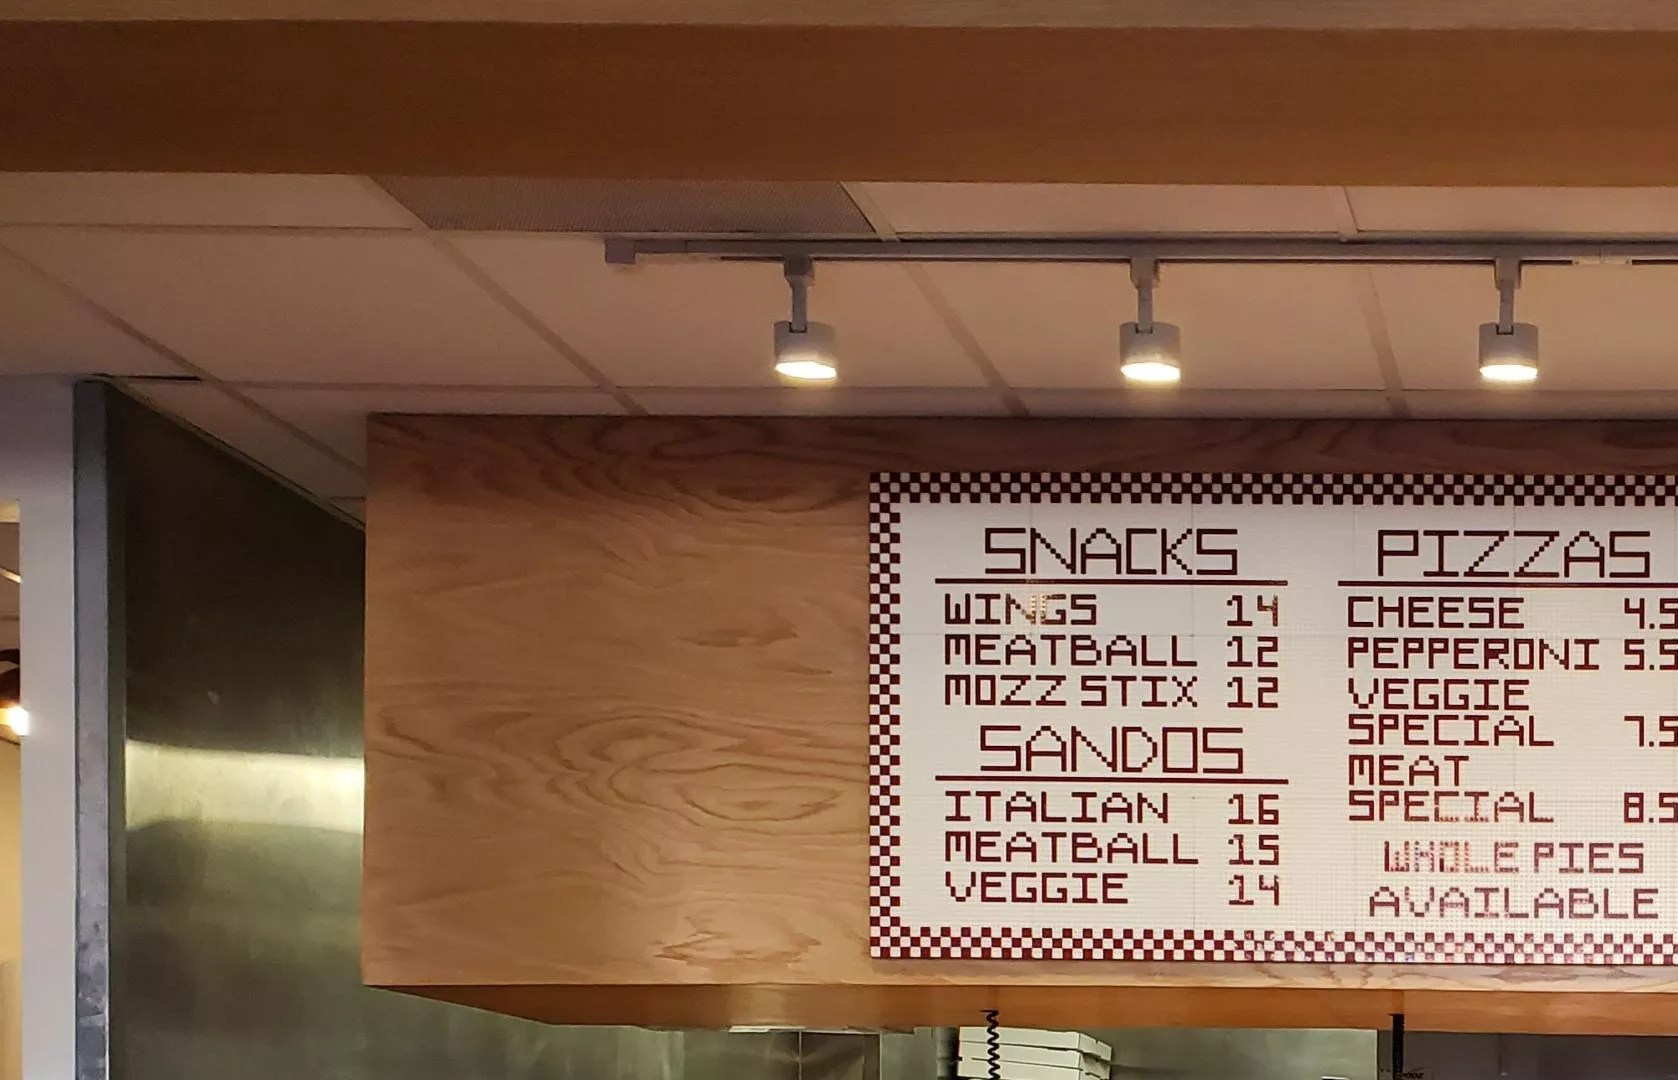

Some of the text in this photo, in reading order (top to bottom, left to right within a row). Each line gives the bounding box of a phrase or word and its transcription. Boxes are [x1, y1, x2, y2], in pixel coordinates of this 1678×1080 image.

[985, 528, 1238, 576] SNACKS
[1377, 530, 1651, 578] PIZZAS
[945, 593, 1278, 626] WINGS 14
[1348, 596, 1524, 628] CHEESE
[945, 634, 1278, 667] MEATBALL 12
[1348, 637, 1678, 670] PEPPERONI 5.5
[945, 675, 1278, 708] MOZZ STIX 12
[1349, 678, 1529, 711] VEGGIE
[1349, 715, 1678, 747] SPECIAL 7.5
[979, 726, 1243, 775] SANDOS
[1349, 755, 1469, 787] MEAT
[945, 791, 1279, 825] ITALIAN 16
[1349, 792, 1678, 823] SPECIAL 8.5
[945, 831, 1279, 865] MEATBALL 15
[1384, 841, 1643, 873] WHOLE PIES
[946, 871, 1279, 905] VEGGIE 14
[1370, 886, 1658, 919] AVAILABLE
